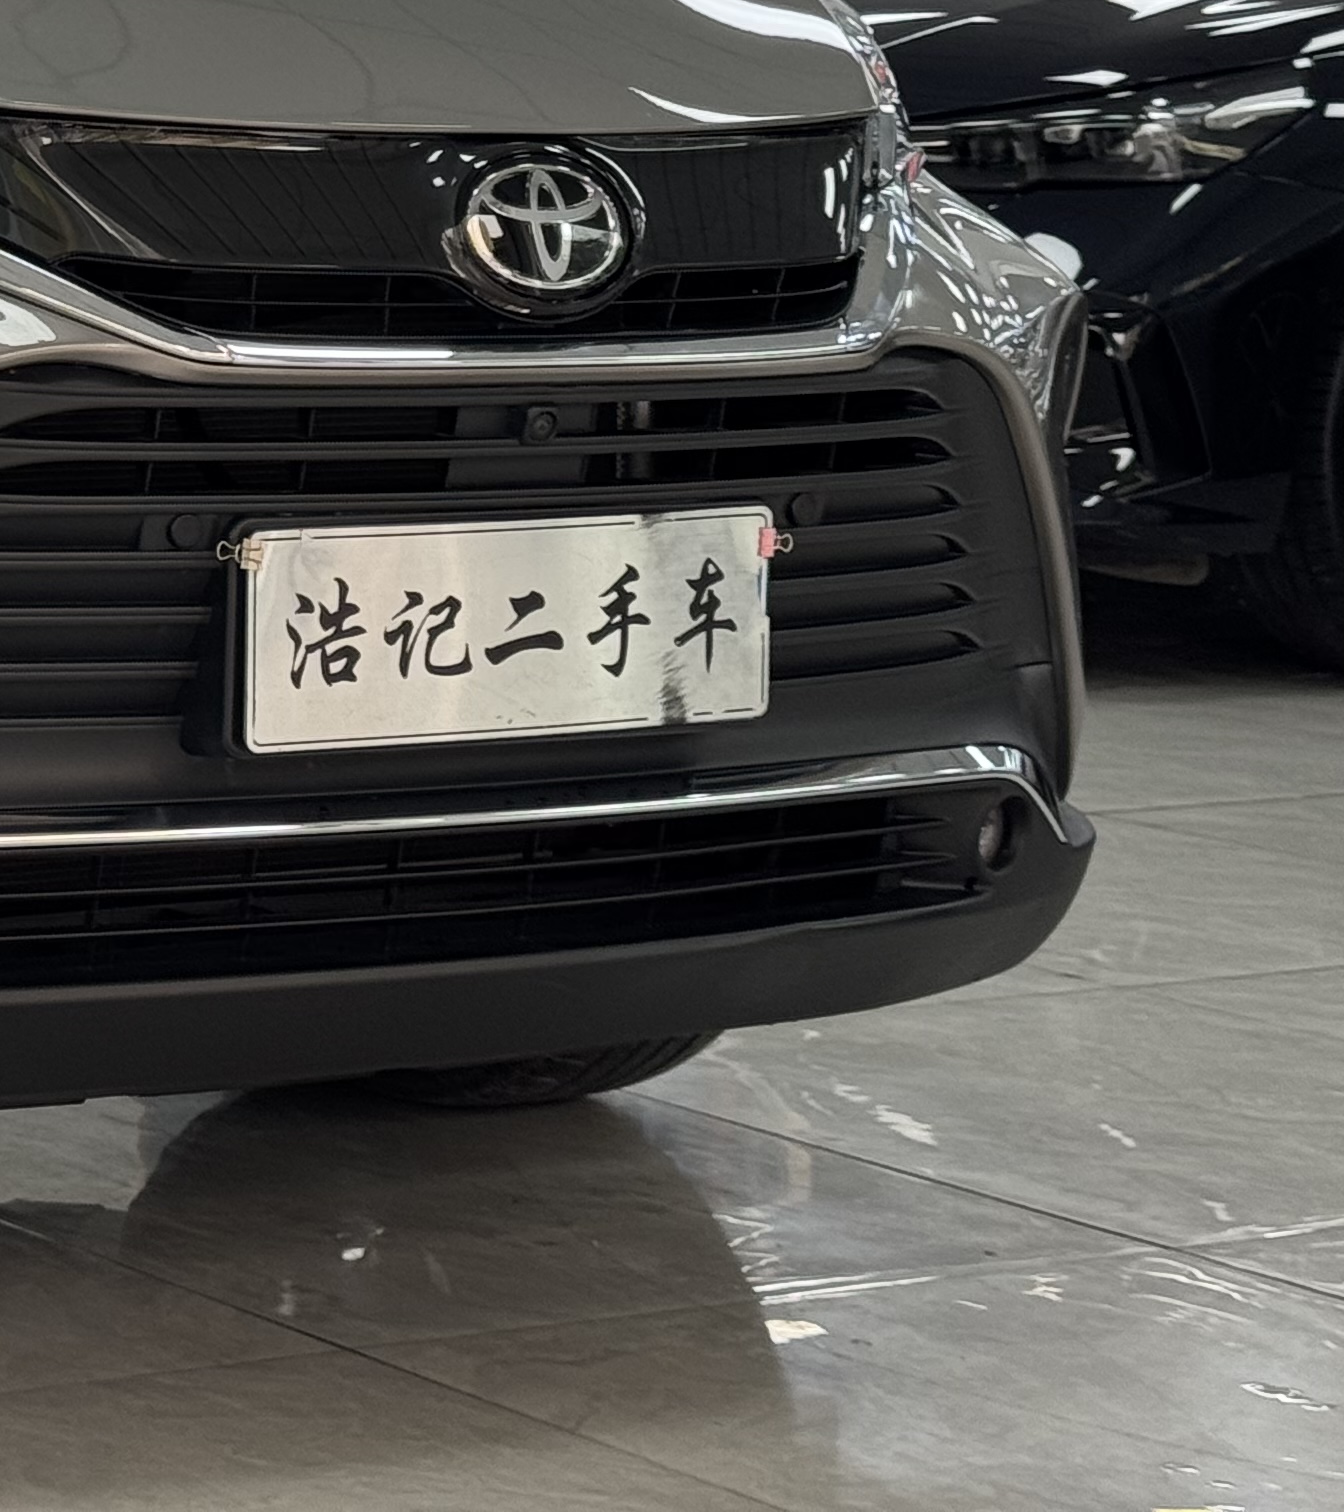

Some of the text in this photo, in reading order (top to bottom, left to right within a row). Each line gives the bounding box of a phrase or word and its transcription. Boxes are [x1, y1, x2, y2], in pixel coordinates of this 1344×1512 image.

[285, 556, 738, 690] 浩记二手车
